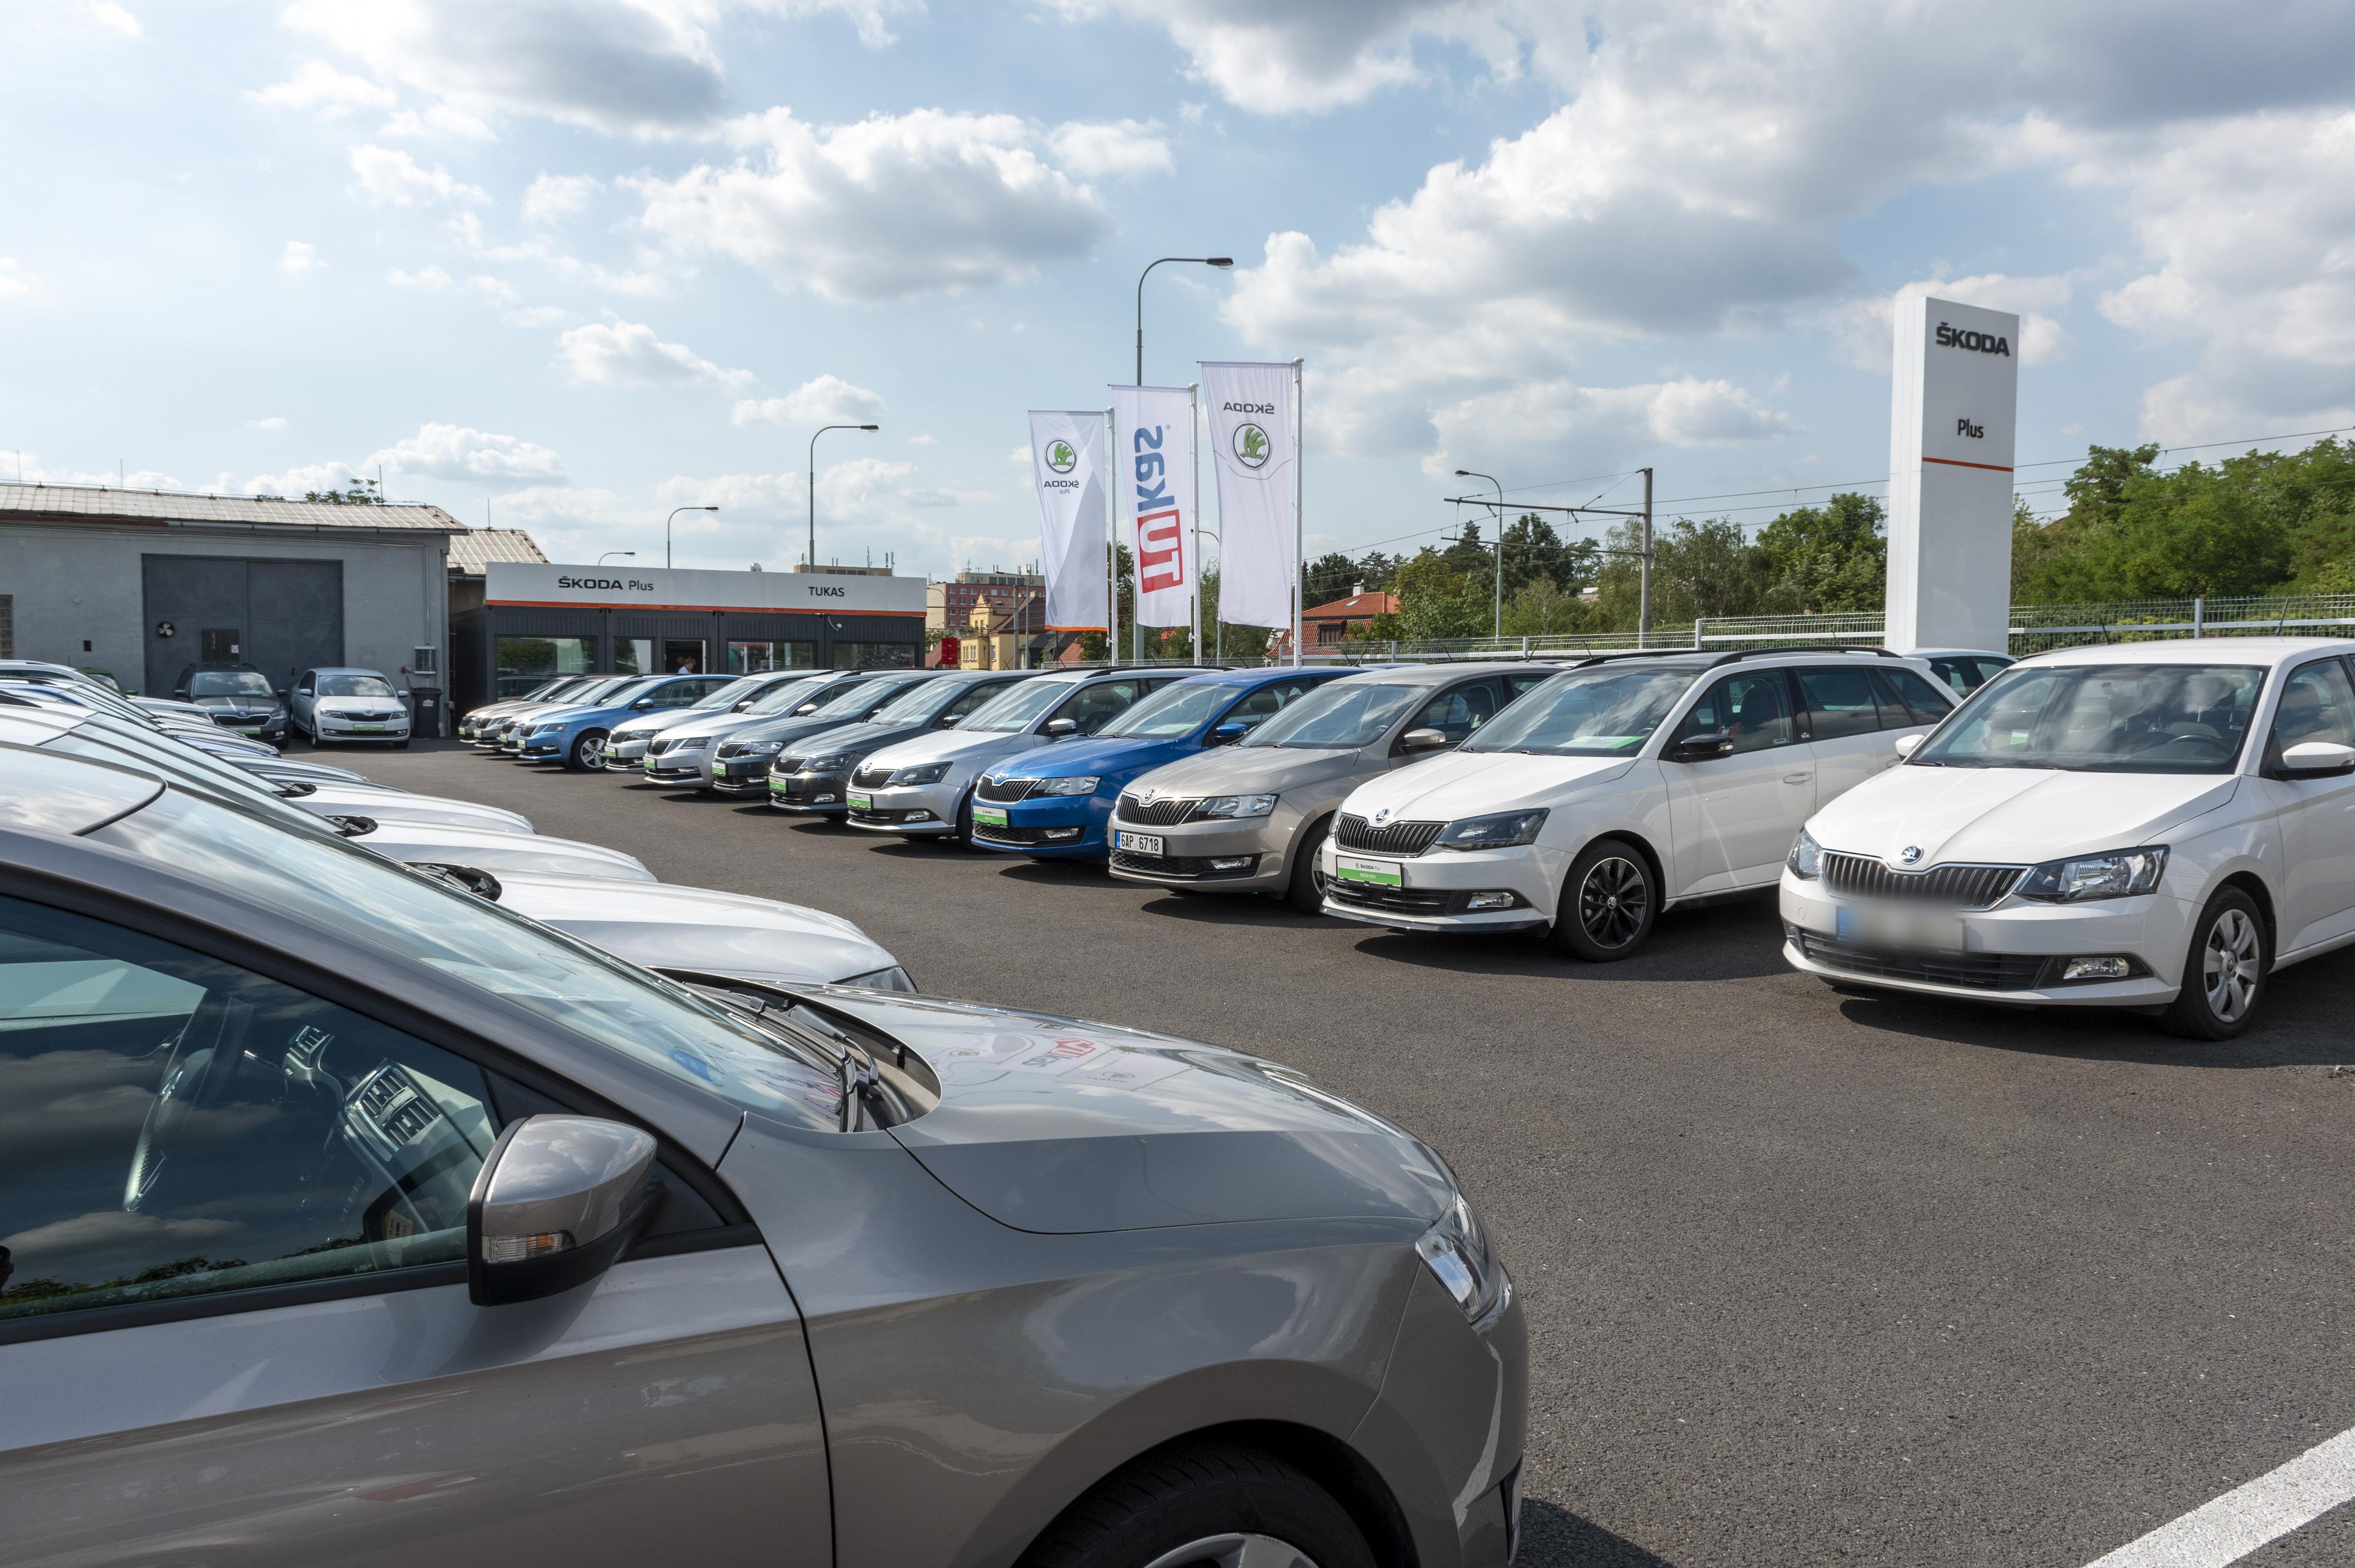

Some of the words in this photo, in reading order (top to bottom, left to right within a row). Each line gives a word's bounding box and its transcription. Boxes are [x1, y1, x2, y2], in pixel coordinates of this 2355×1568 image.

[1936, 321, 2010, 357] ŠKODA
[1957, 418, 1984, 438] Plus
[558, 576, 623, 590] ŠKODA
[629, 580, 654, 591] Plus
[808, 587, 844, 597] TUKAS
[1121, 834, 1134, 848] 6AP
[1139, 836, 1159, 852] 6718
